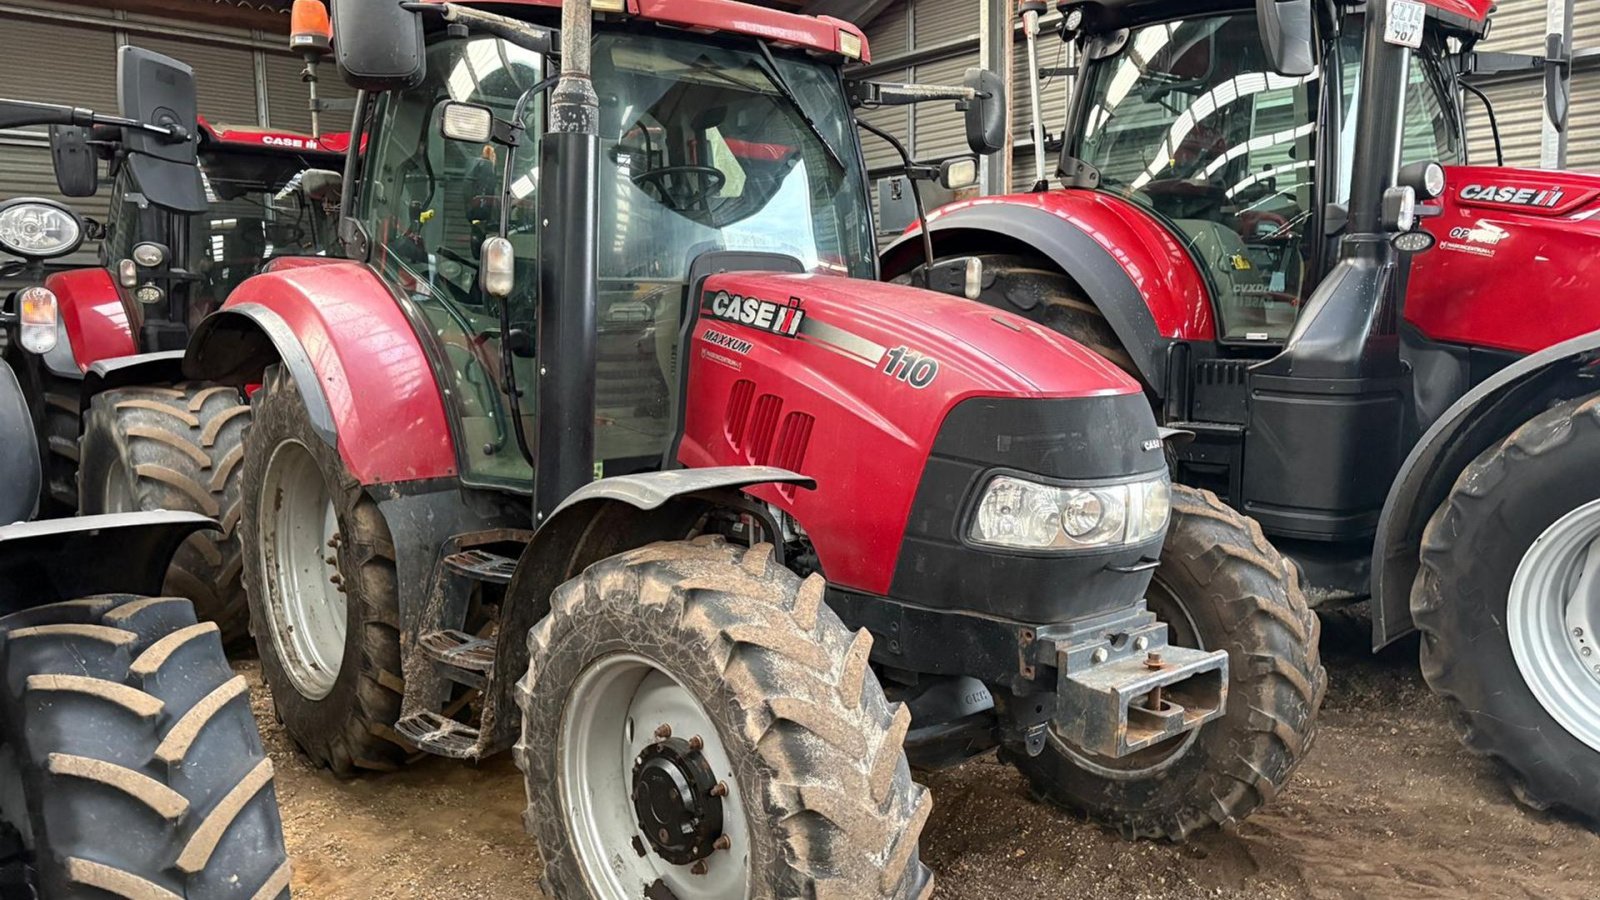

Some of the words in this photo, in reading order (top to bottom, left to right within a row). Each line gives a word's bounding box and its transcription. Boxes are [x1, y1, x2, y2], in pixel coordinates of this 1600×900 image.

[262, 136, 302, 147] CASE
[1460, 184, 1536, 204] CASE
[712, 291, 777, 328] CASE
[702, 330, 753, 354] MAXXUM
[883, 345, 938, 389] 110
